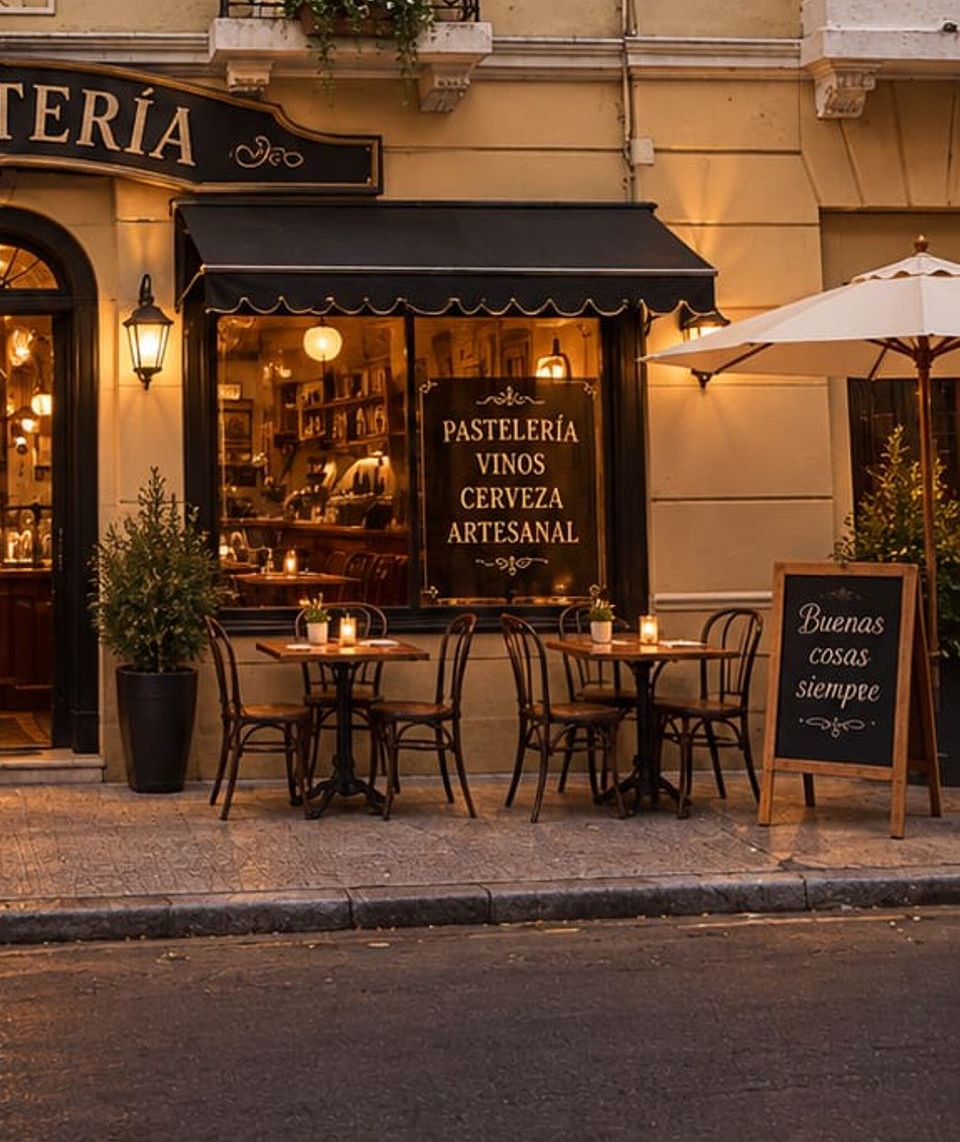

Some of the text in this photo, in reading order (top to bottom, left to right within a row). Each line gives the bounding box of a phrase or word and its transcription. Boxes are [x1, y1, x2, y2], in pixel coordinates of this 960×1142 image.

[442, 414, 580, 443] PASTELERÍA
[475, 452, 546, 475] VINOS
[459, 486, 564, 510] CERVEZA
[446, 520, 580, 544] ARTESANAL
[797, 602, 885, 635] Buenas
[809, 646, 870, 668] cosas
